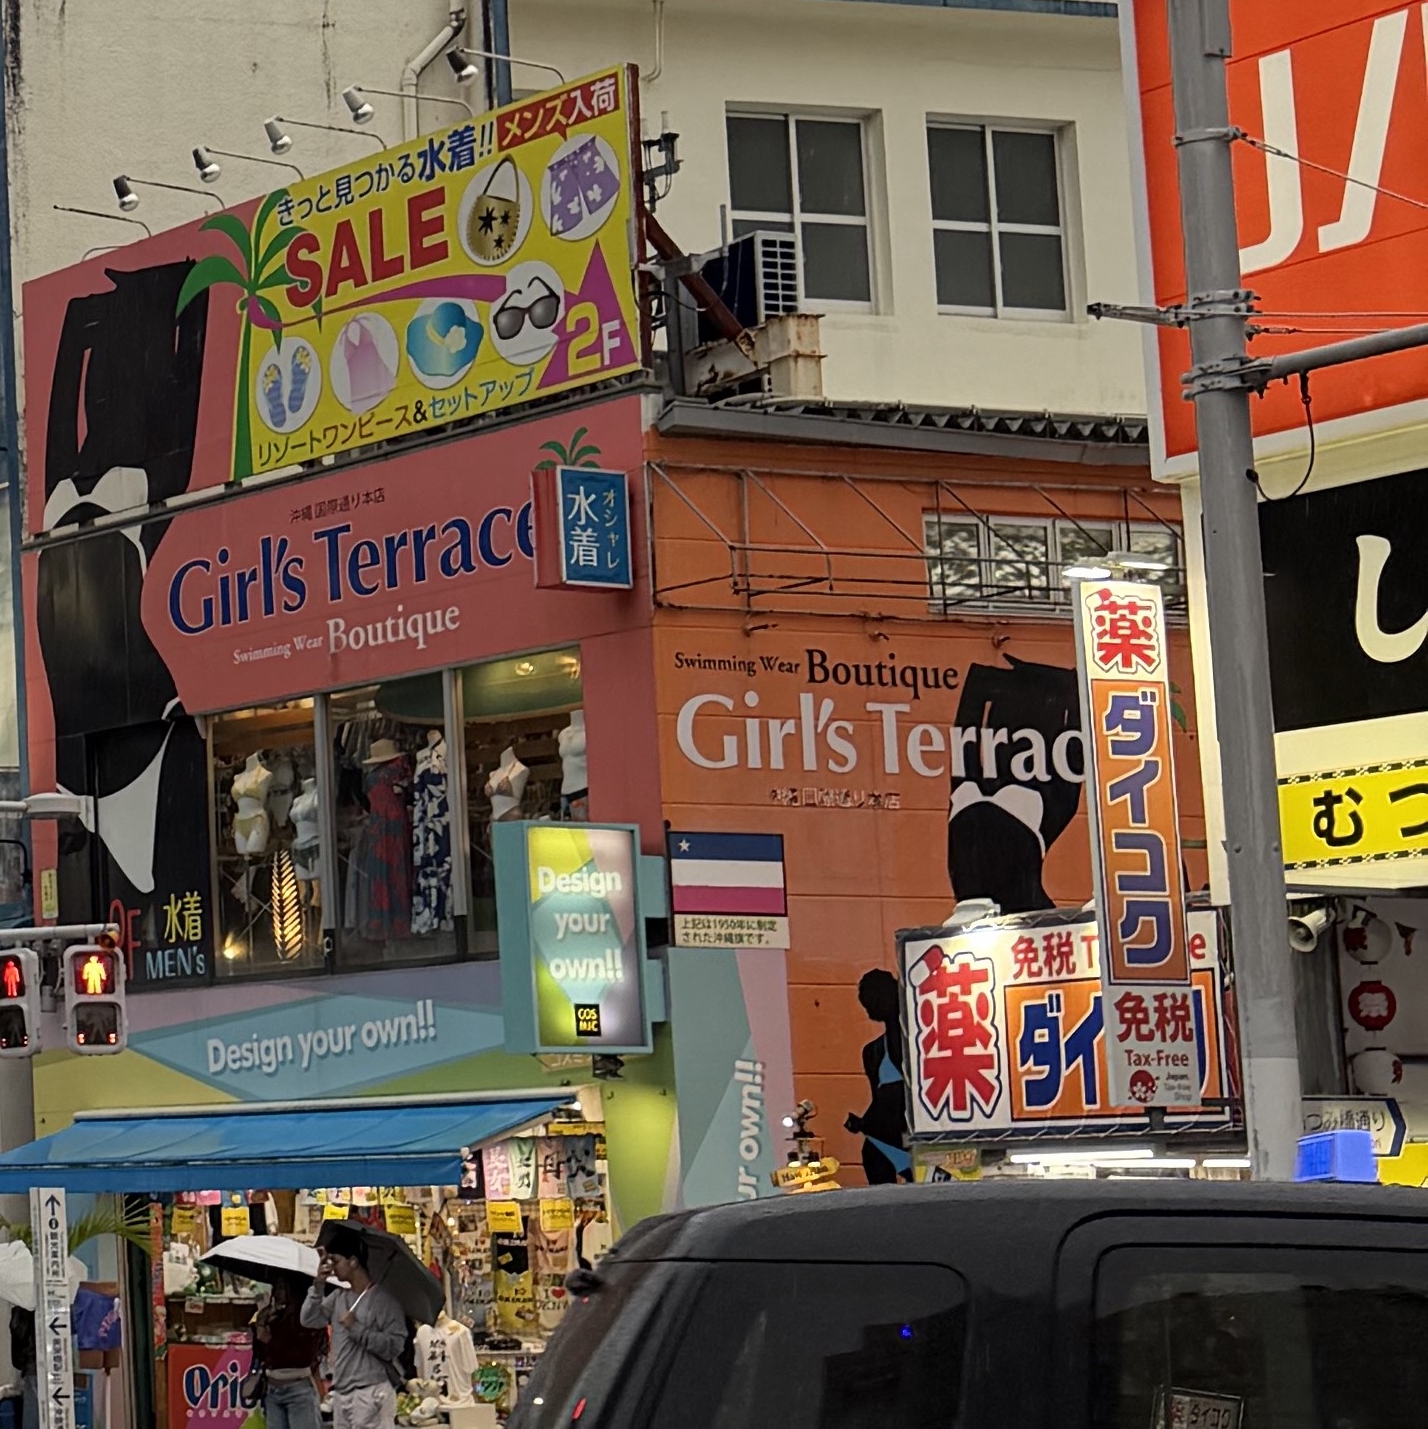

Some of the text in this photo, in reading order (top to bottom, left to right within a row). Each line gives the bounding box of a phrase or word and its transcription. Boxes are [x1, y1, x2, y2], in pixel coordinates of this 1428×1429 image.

[498, 74, 618, 147] メンズ入荷
[286, 187, 449, 308] SALE
[566, 302, 623, 378] 2F
[567, 485, 600, 567] 水着
[603, 489, 620, 569] オシャレ
[233, 604, 460, 665] Swimming Wear Boutique
[1086, 588, 1161, 675] 薬
[674, 648, 960, 700] Swimming Wear Boutique
[676, 690, 1086, 784] Girl's Terrac
[1103, 691, 1172, 967] ダイコク
[538, 868, 622, 897] Design
[163, 890, 203, 943] 水着
[554, 911, 610, 939] your
[549, 949, 624, 981] own!!
[1010, 931, 1076, 979] 免税
[207, 999, 436, 1074] Design your own!!
[917, 962, 996, 1112] 薬
[1114, 992, 1194, 1044] 免税
[1124, 1049, 1189, 1067] Tax-Free
[1303, 1111, 1385, 1131] つみ橋通り
[185, 1361, 257, 1410] Ori
